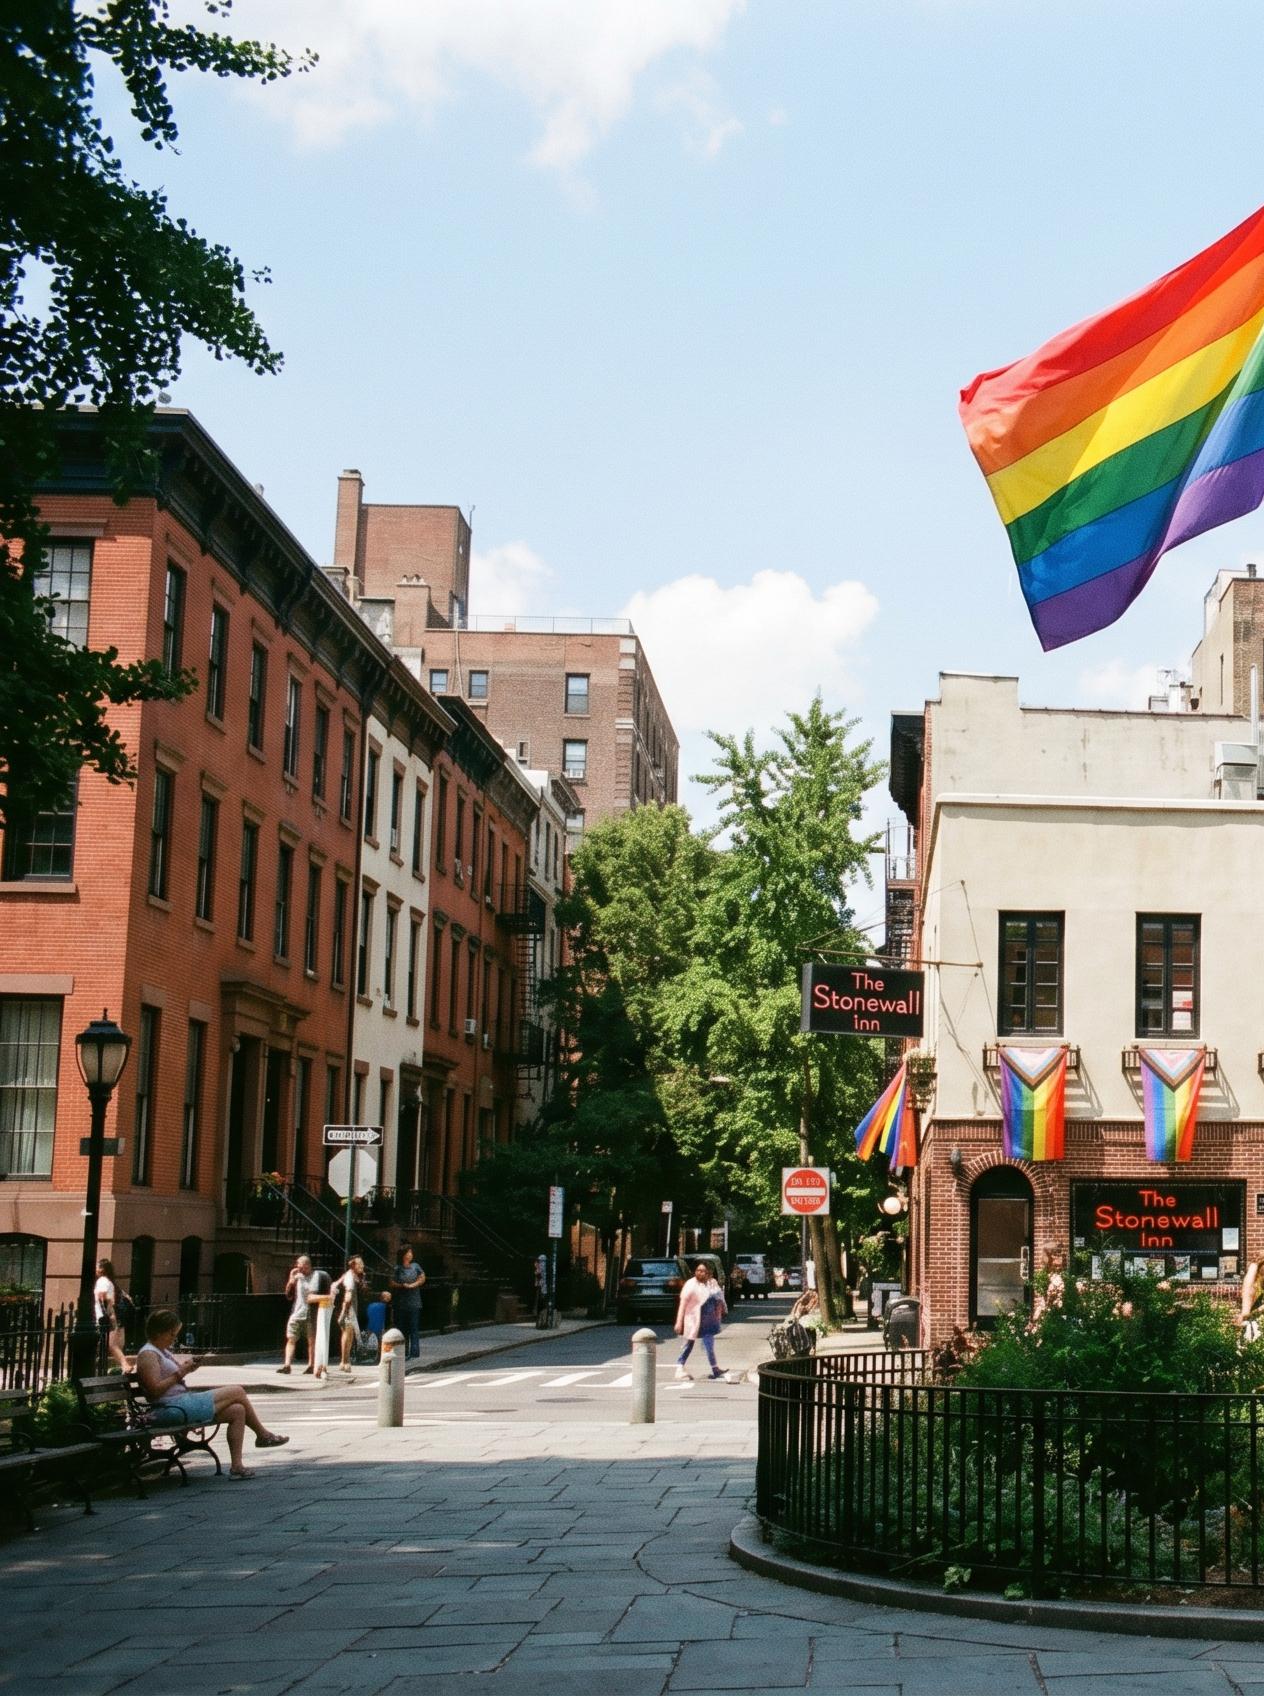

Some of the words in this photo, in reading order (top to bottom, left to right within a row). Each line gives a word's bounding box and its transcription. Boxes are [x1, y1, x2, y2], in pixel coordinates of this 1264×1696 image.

[851, 972, 885, 991] The
[814, 985, 919, 1014] Stonewall
[1140, 1190, 1176, 1207] The
[1096, 1206, 1218, 1229] Stonewall
[1141, 1231, 1173, 1248] Inn
